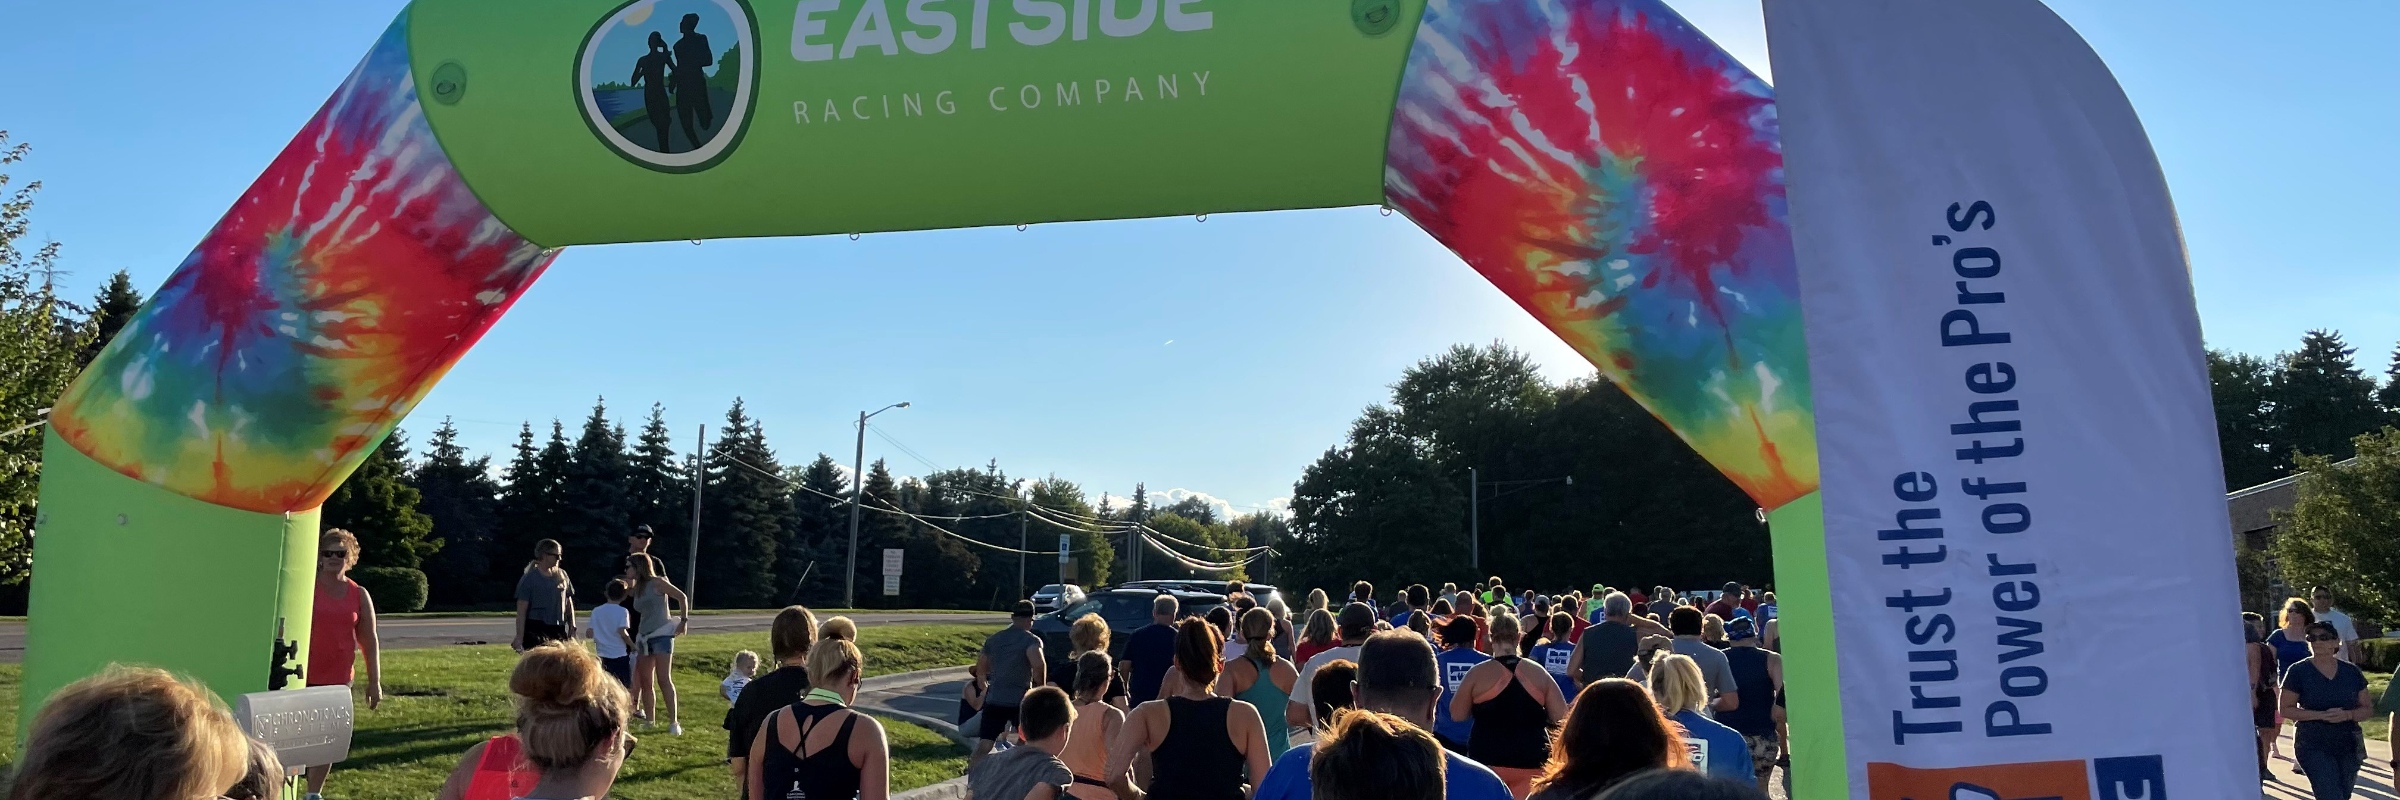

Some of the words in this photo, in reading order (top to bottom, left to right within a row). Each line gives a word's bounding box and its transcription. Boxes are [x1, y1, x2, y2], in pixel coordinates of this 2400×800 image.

[793, 91, 956, 124] RACING
[989, 71, 1210, 111] COMPANY
[1932, 200, 2011, 347] Pro's
[1950, 361, 2025, 464] the
[1877, 471, 1948, 569] the
[1961, 477, 2031, 534] of
[1885, 587, 1962, 746] Trust
[1984, 553, 2053, 737] Power
[272, 706, 350, 725] CHRONOTRACK
